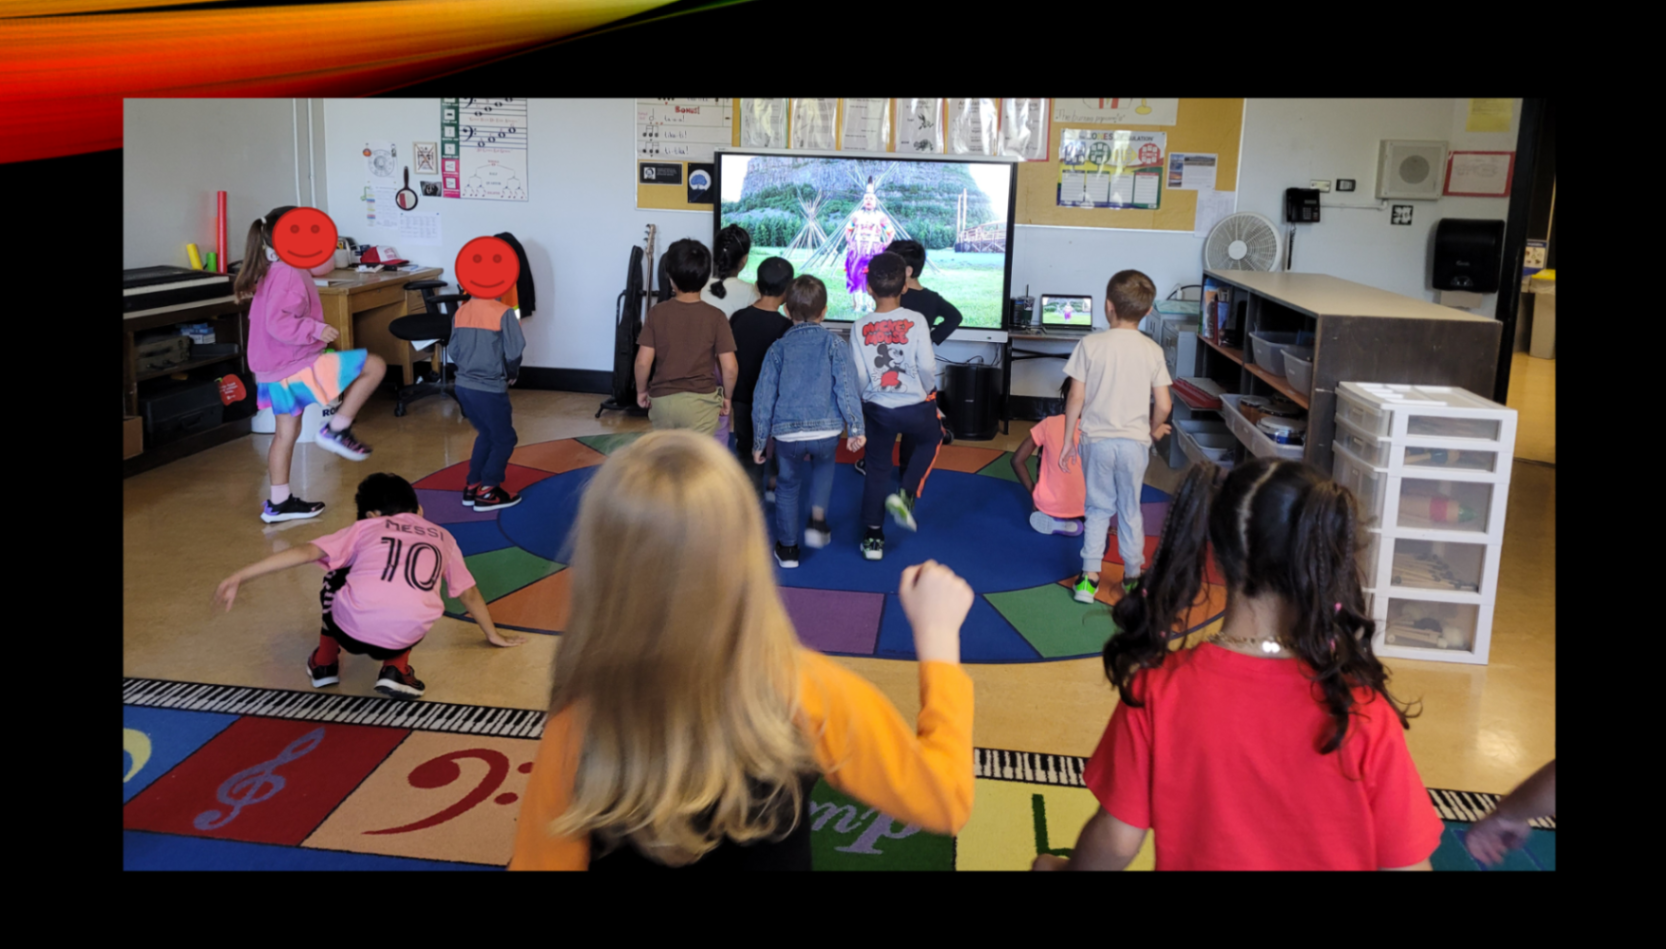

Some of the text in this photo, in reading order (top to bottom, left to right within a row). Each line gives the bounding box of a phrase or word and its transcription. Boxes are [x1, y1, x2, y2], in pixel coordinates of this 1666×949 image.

[1090, 132, 1114, 141] ONES
[862, 319, 914, 337] MICKEY
[864, 330, 908, 346] MOUSE
[386, 519, 444, 541] MESSI
[381, 537, 443, 592] 10
